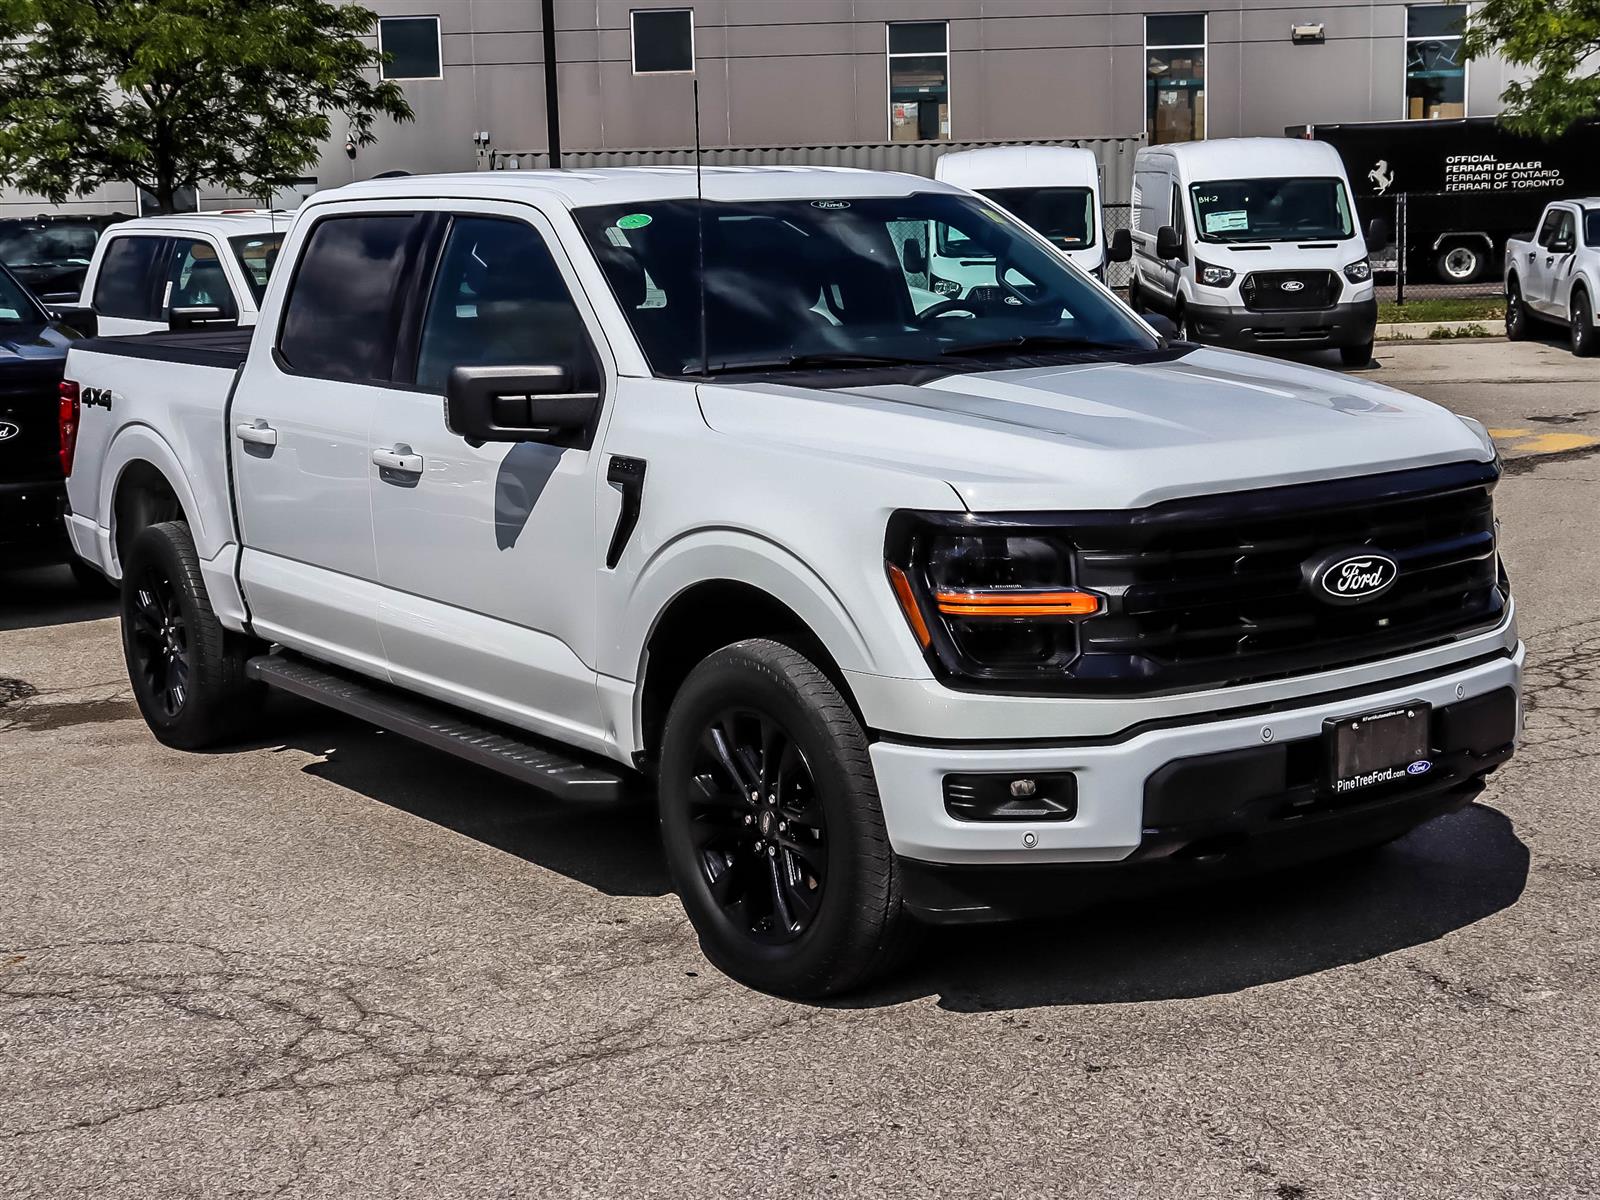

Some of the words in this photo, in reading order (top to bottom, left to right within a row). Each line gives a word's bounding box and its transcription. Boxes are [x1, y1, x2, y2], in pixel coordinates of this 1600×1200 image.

[1446, 154, 1497, 164] OFFICIAL
[1446, 164, 1494, 173] FERRARI
[1497, 161, 1542, 171] DEALER
[1446, 173, 1491, 182] FERRARI
[1494, 172, 1508, 180] OF
[1511, 169, 1560, 179] ONTARIO
[1446, 182, 1491, 192] FERRARI
[1494, 181, 1508, 190] OF
[1511, 178, 1564, 189] TORONTO
[1198, 195, 1219, 204] BH-2
[1337, 561, 1384, 592] Ford
[1337, 768, 1406, 792] PineTreeFord.com
